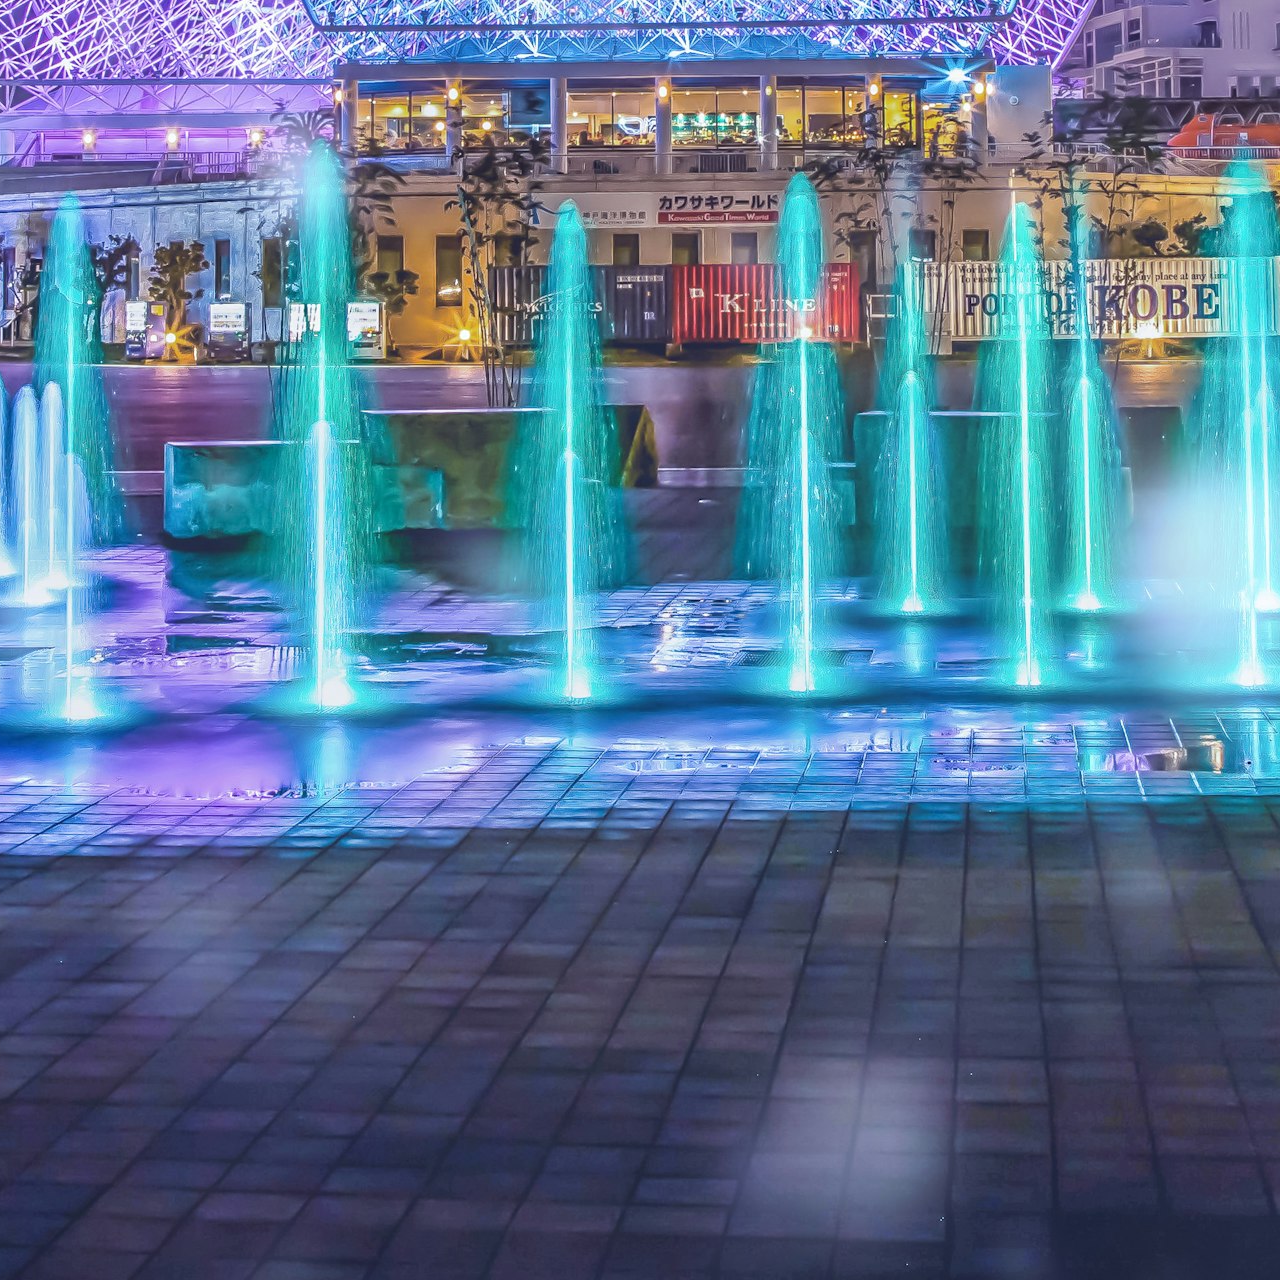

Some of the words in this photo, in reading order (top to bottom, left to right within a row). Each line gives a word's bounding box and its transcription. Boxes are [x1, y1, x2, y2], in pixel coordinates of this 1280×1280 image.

[659, 194, 779, 210] カワサキワールド
[704, 212, 725, 221] Good
[746, 212, 769, 221] World
[754, 298, 816, 312] LINE
[1094, 283, 1220, 321] KOBE
